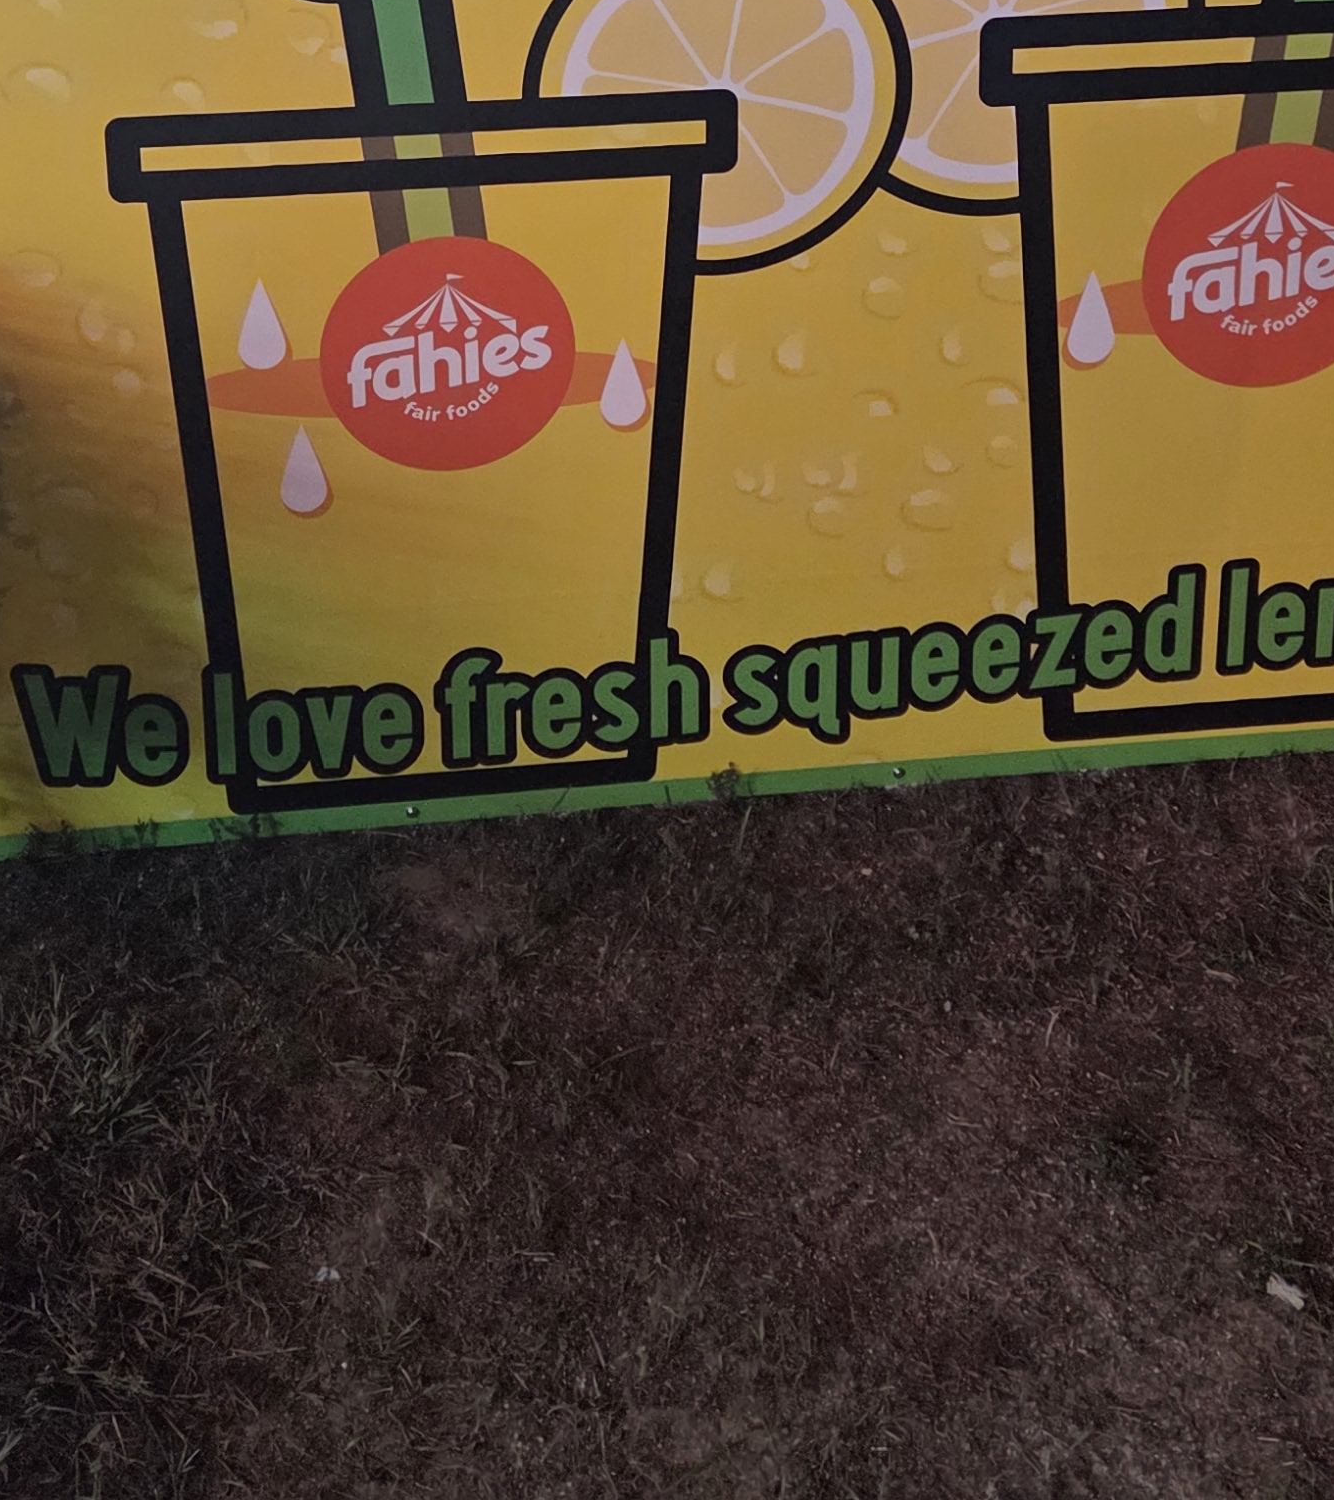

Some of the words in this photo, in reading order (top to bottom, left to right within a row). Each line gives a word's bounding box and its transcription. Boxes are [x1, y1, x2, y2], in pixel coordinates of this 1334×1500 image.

[1220, 314, 1257, 336] fair
[1262, 295, 1318, 335] foods
[347, 325, 552, 408] fahies
[404, 401, 441, 422] fair
[446, 381, 500, 420] foods
[12, 665, 187, 785] We
[203, 665, 422, 782] love
[440, 629, 708, 766] fresh
[725, 566, 1204, 743] squeezed
